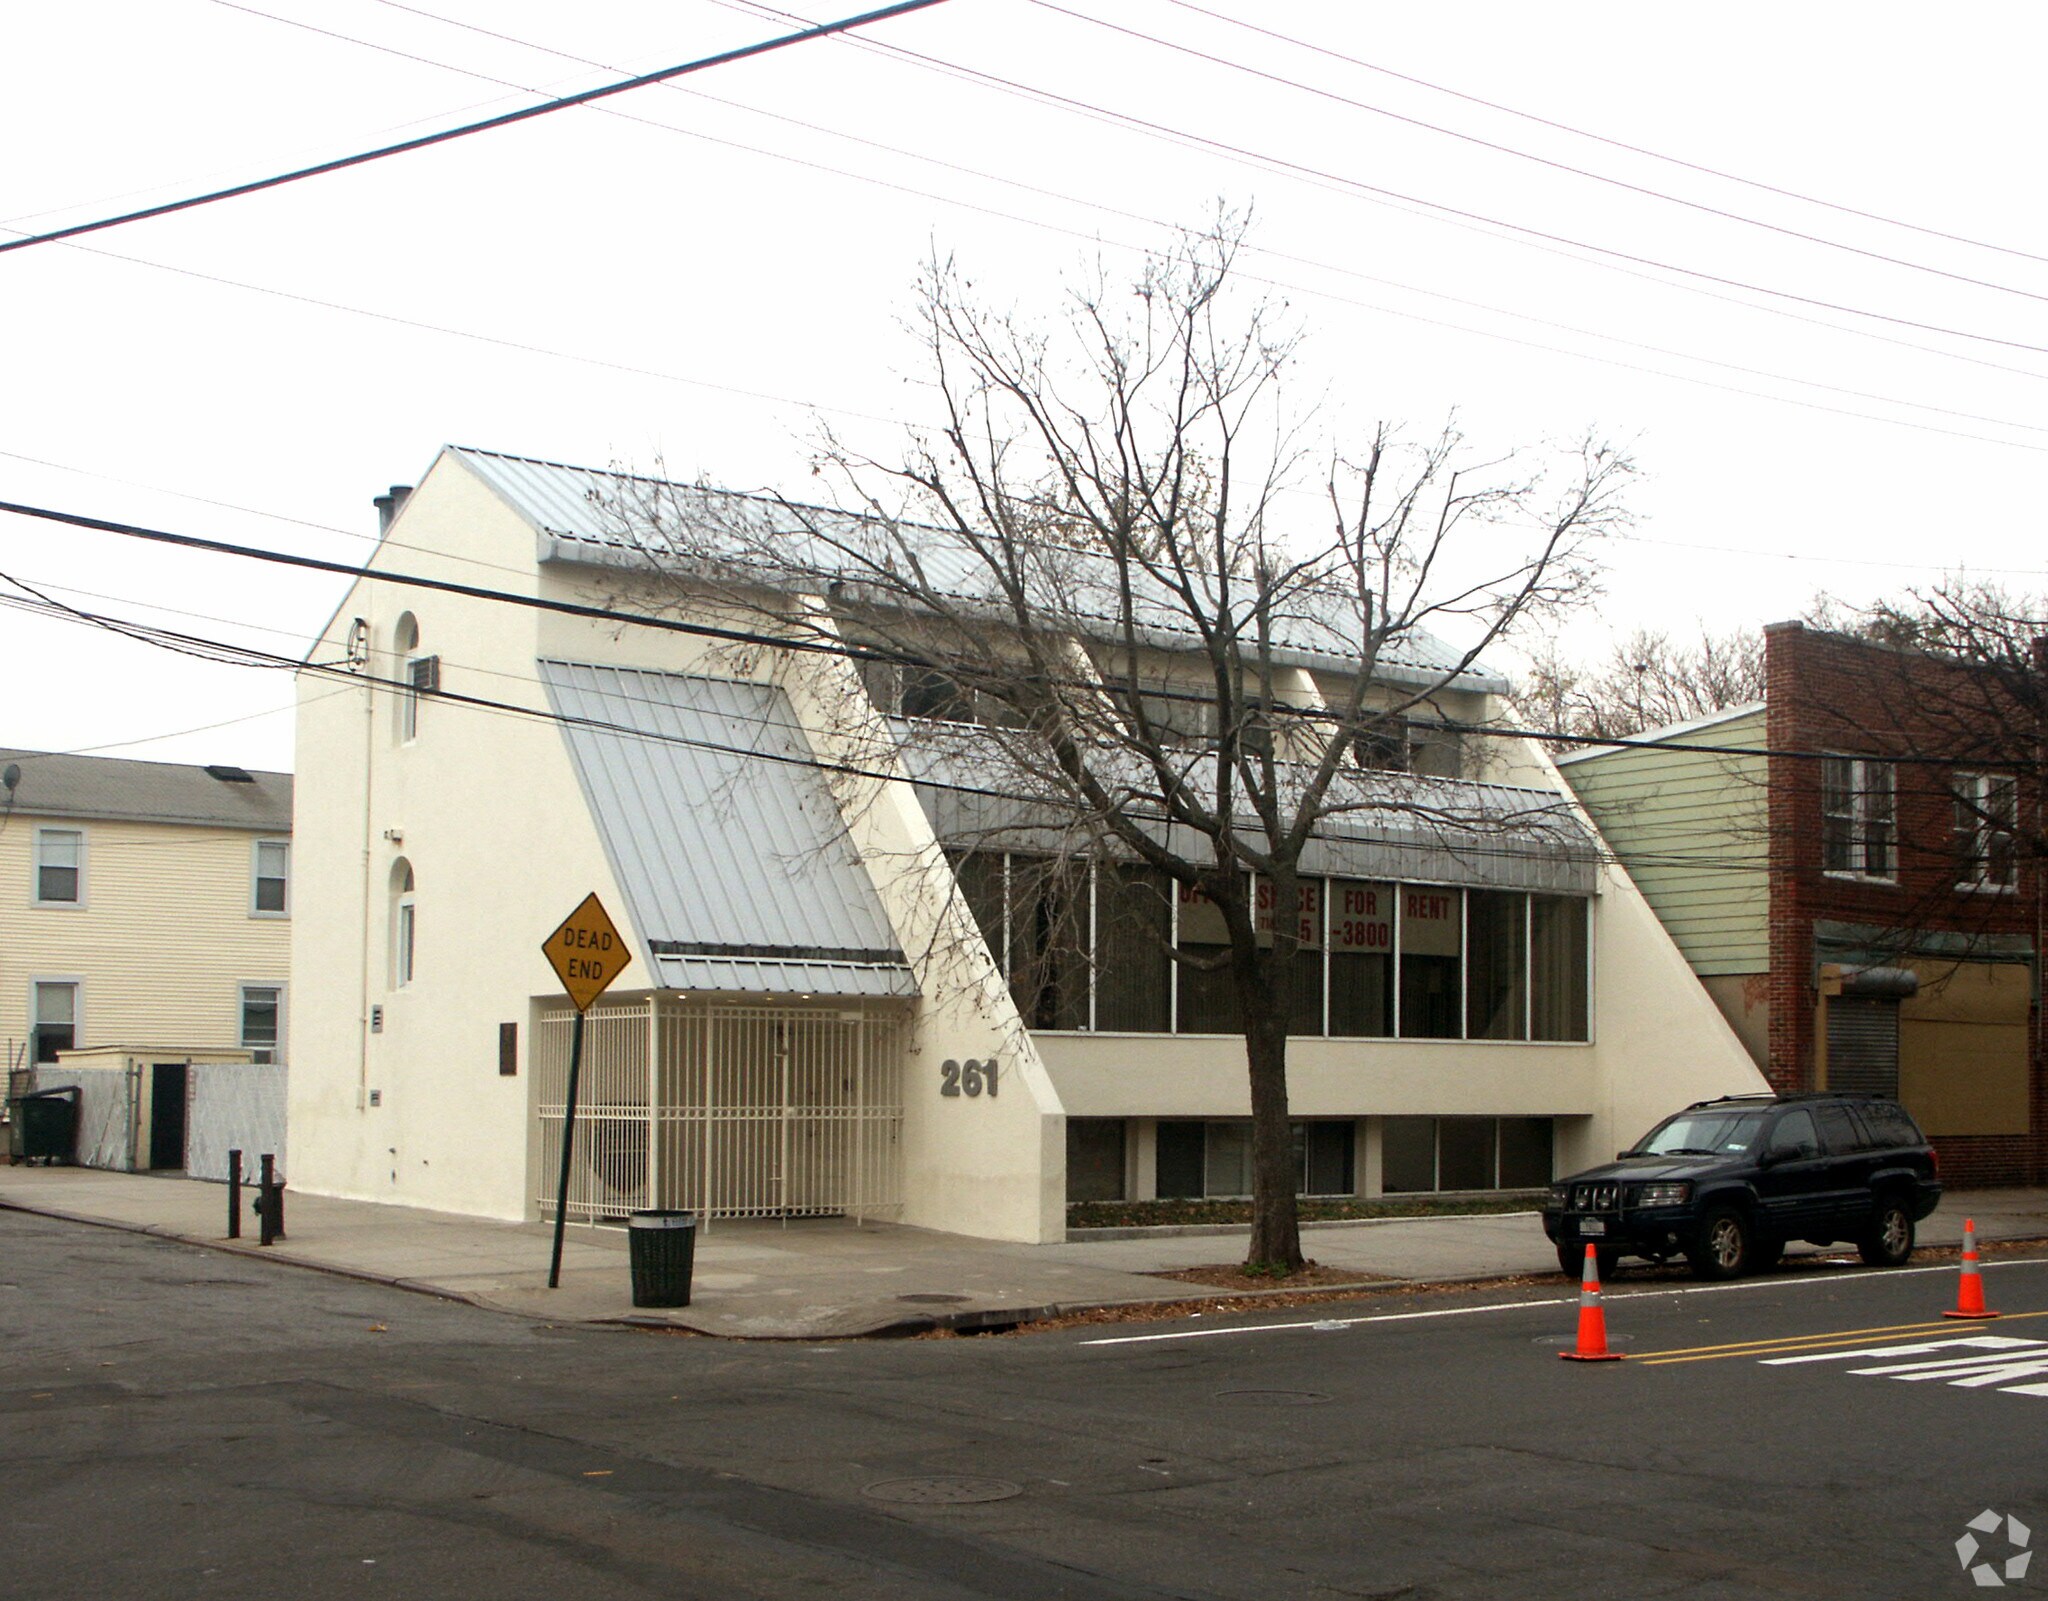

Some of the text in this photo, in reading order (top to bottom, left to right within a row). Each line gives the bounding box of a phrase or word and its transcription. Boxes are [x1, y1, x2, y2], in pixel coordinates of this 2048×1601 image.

[1345, 889, 1377, 916] FOR
[1407, 894, 1450, 920] RENT
[564, 927, 613, 951] DEAD
[568, 958, 603, 980] END
[940, 1058, 998, 1098] 261
